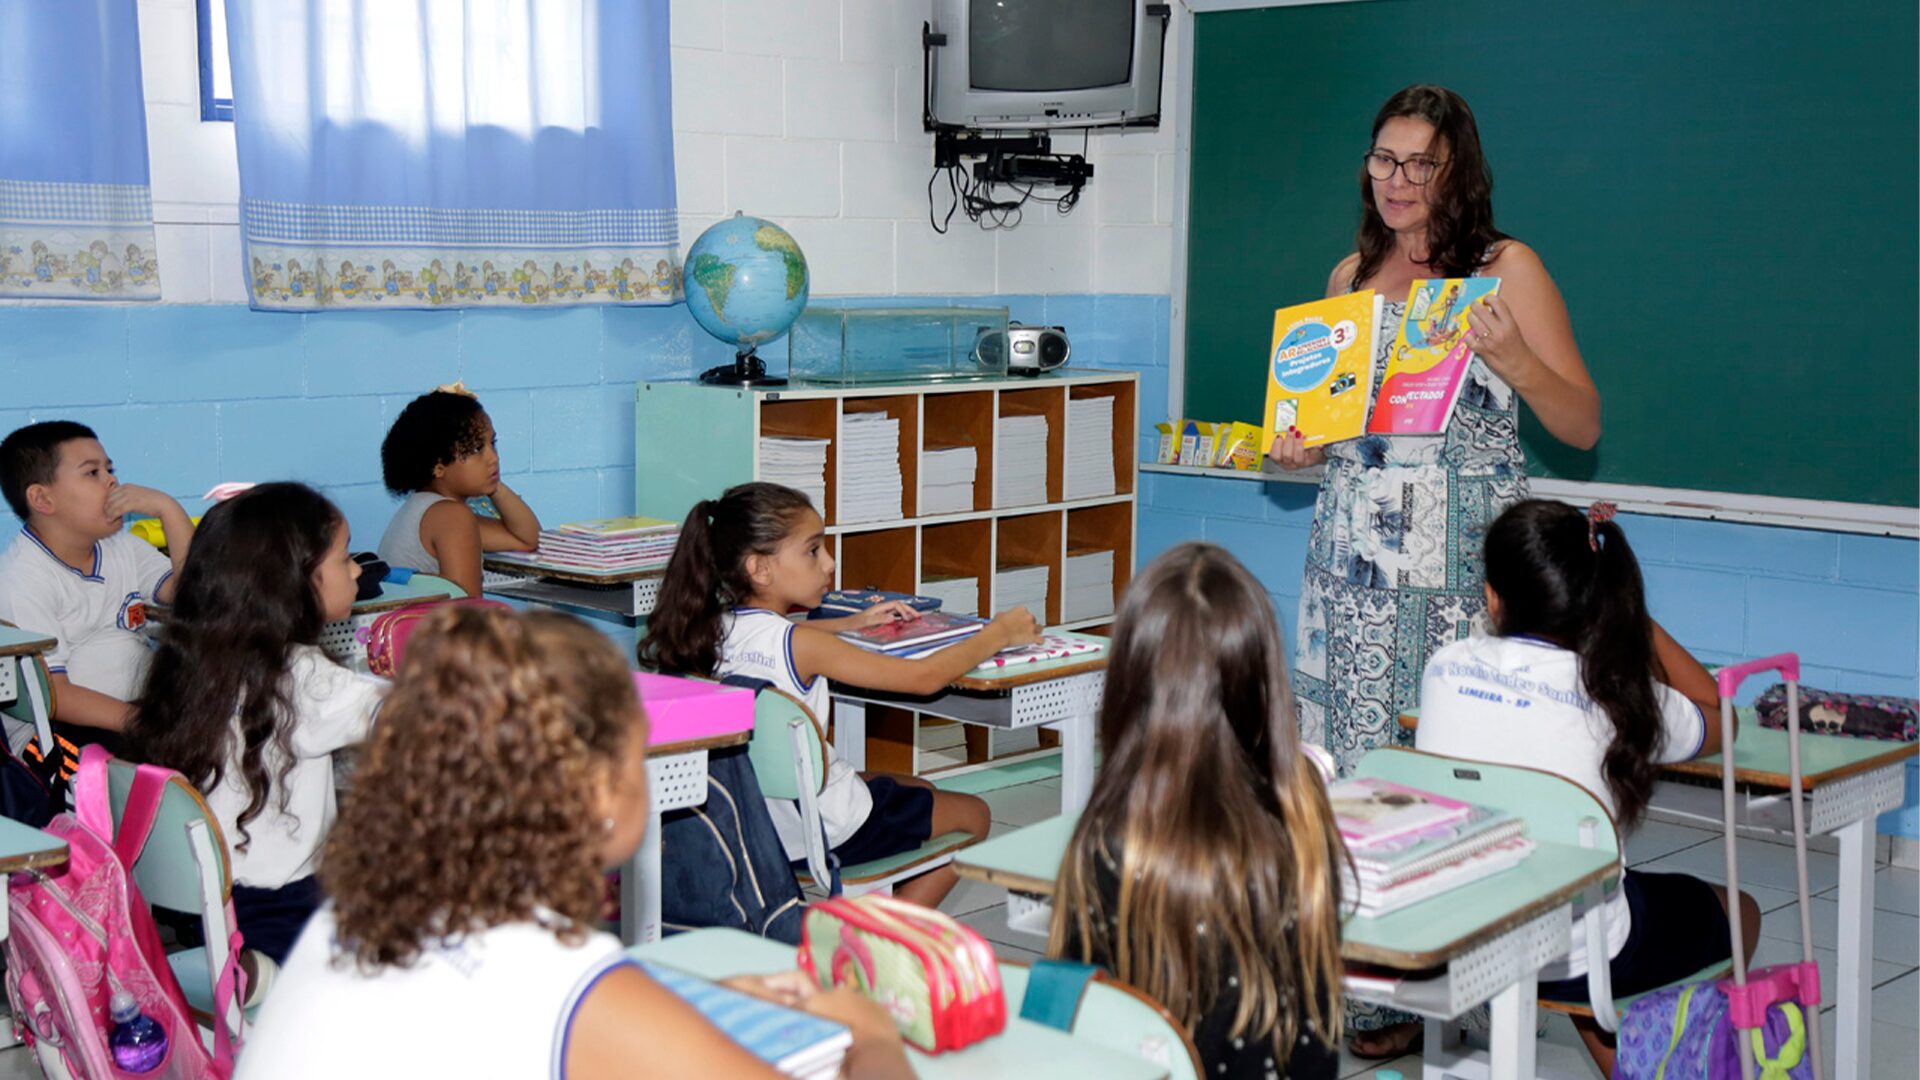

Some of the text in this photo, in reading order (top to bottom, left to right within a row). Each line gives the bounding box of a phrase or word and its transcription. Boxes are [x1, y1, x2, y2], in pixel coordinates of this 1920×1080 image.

[1279, 347, 1296, 362] AR
[1458, 686, 1503, 703] LIMEIRA
[1516, 698, 1531, 708] SP
